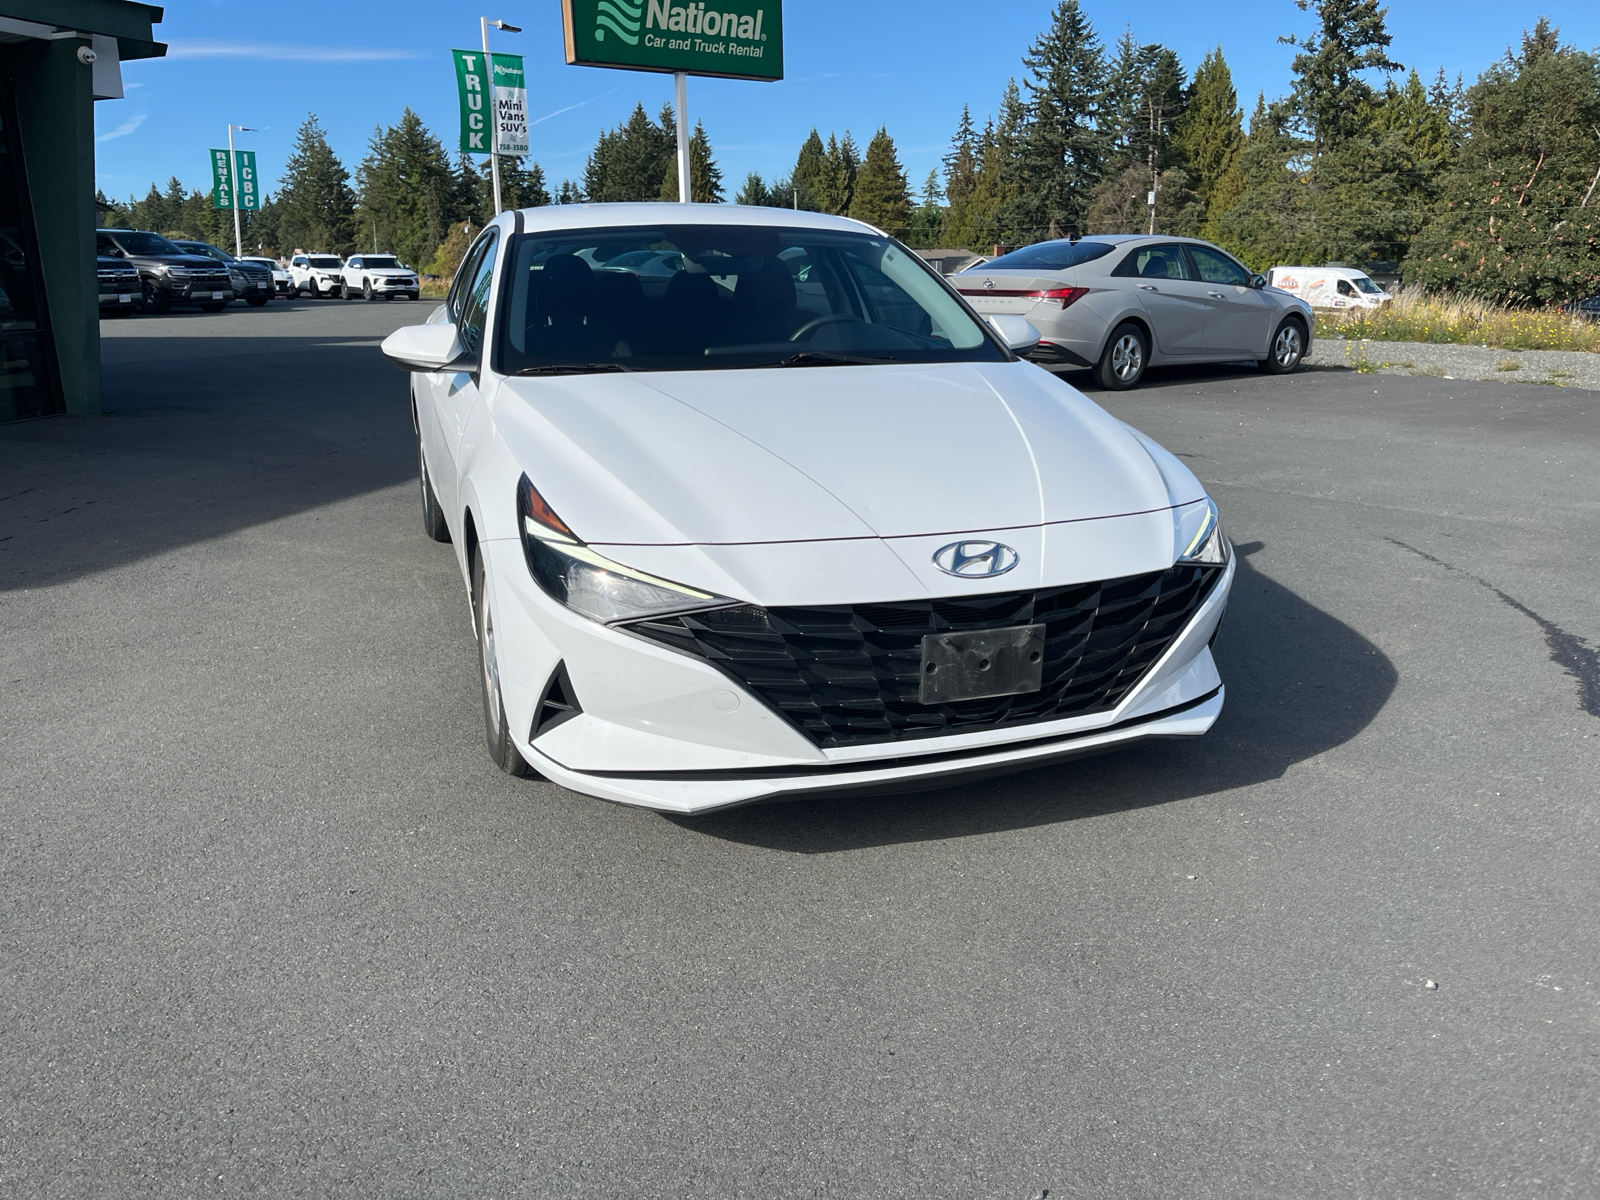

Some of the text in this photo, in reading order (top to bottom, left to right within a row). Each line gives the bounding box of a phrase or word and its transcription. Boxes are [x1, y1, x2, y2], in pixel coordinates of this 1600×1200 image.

[645, 34, 764, 57] Car and Truck Rental
[462, 55, 483, 149] TRUCK
[499, 100, 522, 110] Mini
[499, 111, 525, 121] Vans
[500, 122, 527, 133] SUV's
[499, 143, 528, 151] 758-3580
[215, 152, 229, 206] RENTALS
[242, 153, 254, 207] ICBC
